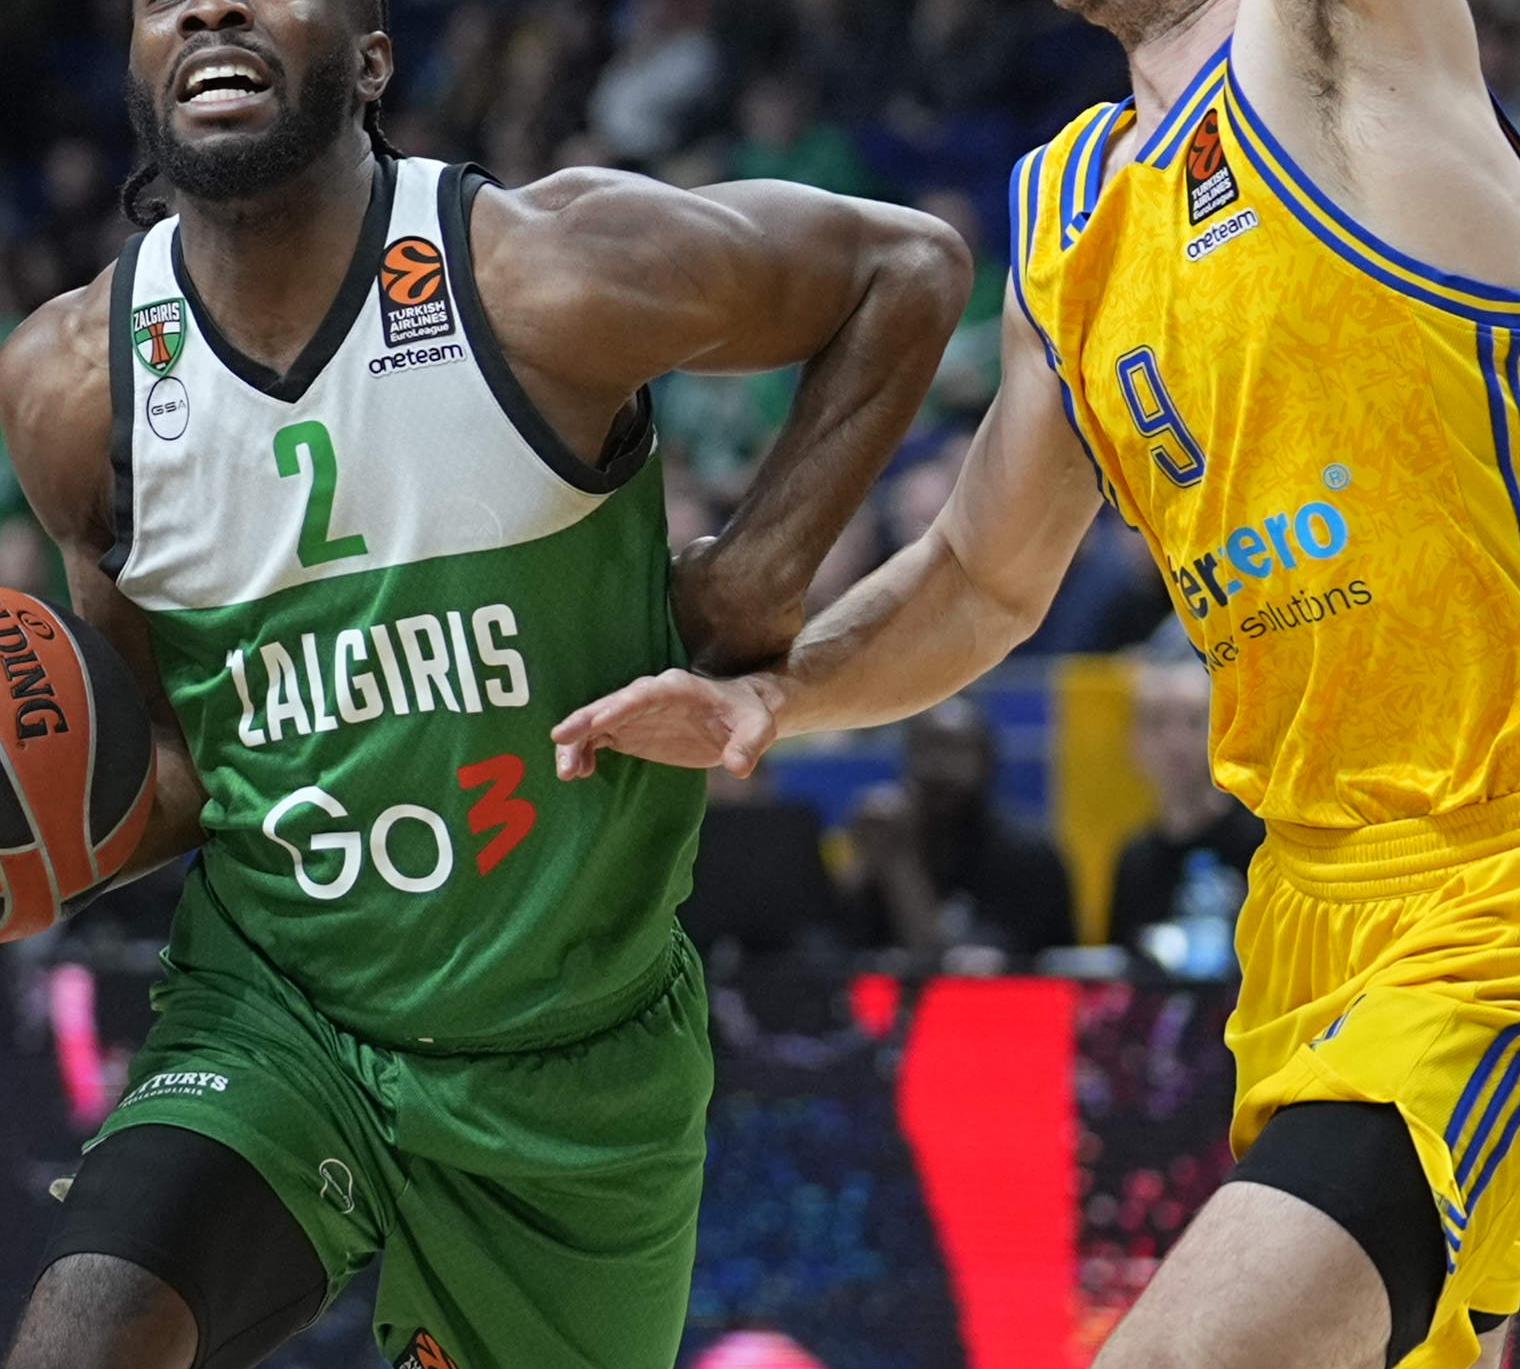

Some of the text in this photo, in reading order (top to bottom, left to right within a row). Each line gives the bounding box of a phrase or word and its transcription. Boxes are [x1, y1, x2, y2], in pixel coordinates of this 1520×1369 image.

[1191, 167, 1229, 199] TURKISH
[1192, 179, 1233, 211] AIRLINES
[387, 300, 446, 322] TURKISH
[389, 311, 448, 333] AIRLINES
[389, 323, 450, 343] EuroLeague
[368, 343, 464, 375] oneteam
[150, 399, 187, 417] GSA
[1116, 344, 1206, 489] 9
[273, 420, 369, 569] 2
